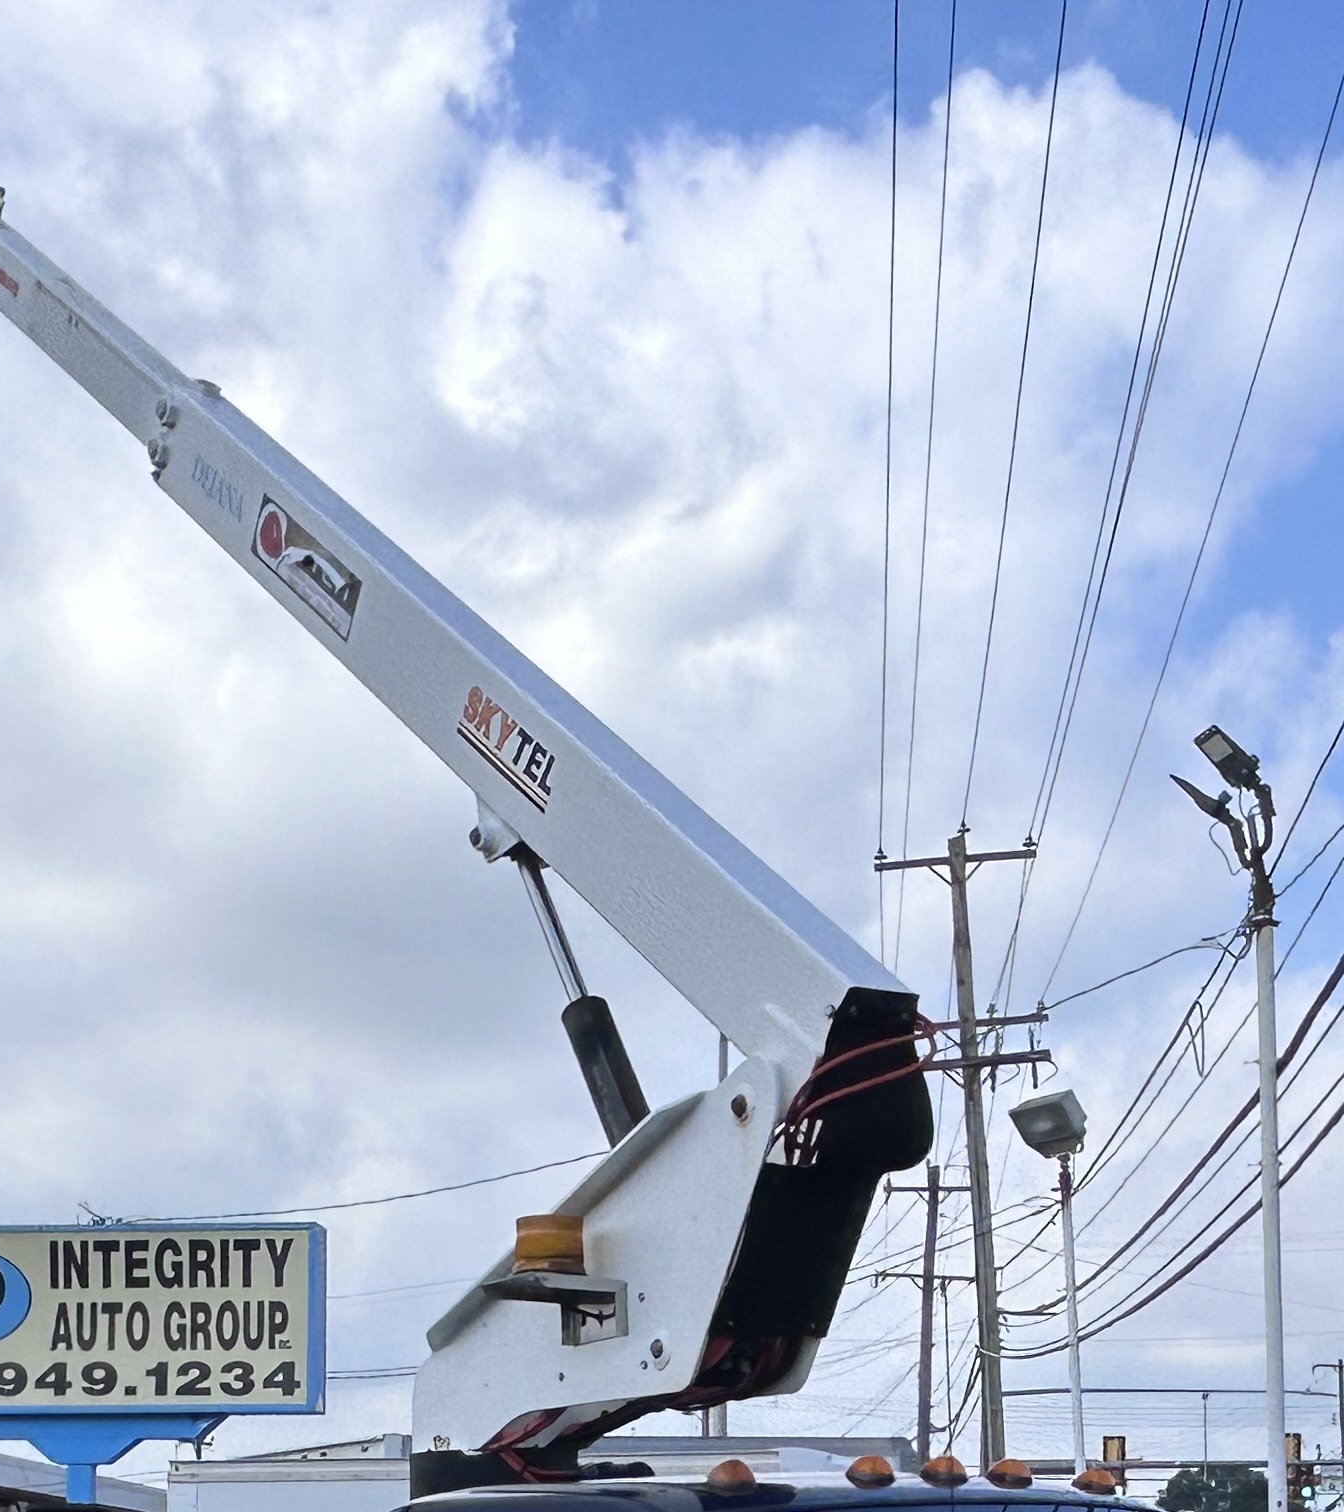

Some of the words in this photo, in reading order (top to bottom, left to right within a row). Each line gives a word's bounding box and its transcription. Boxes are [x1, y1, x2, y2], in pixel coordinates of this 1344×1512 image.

[463, 686, 556, 796] SKYTEL
[49, 1238, 294, 1289] INTEGRITY
[51, 1301, 150, 1351] AUTO
[163, 1300, 289, 1351] GROUP
